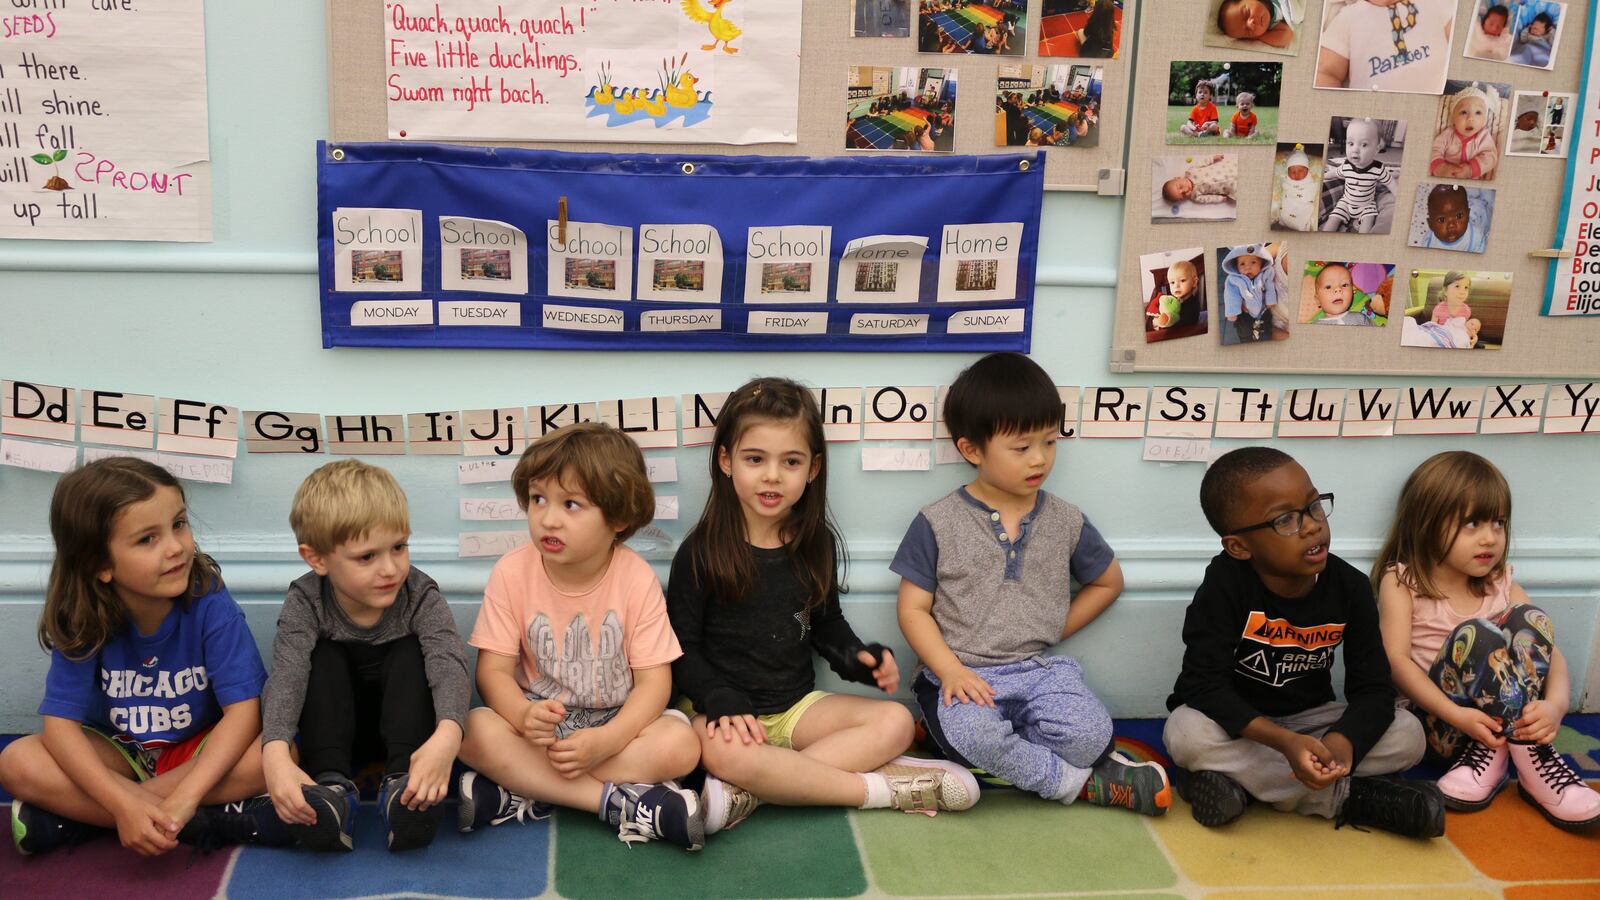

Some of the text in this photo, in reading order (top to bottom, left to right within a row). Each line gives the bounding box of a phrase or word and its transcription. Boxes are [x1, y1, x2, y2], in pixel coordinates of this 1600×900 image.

[3, 12, 57, 38] SEEDS
[18, 52, 87, 80] there.
[391, 38, 582, 78] Five little ducklings.
[1368, 44, 1430, 77] Parker
[41, 89, 110, 116] shine.
[388, 73, 550, 111] Swam right back.
[35, 123, 83, 150] fall.
[14, 192, 107, 226] up tall.
[336, 215, 417, 245] School
[443, 219, 516, 247] School
[550, 224, 622, 257] School
[642, 229, 712, 255] School
[748, 230, 825, 259] School
[945, 229, 1009, 255] Home
[847, 239, 909, 260] Home
[364, 307, 419, 318] MONDAY
[452, 307, 508, 318] TUESDAY
[544, 310, 623, 325] WEDNESDAY
[648, 314, 714, 326] THURSDAY
[764, 317, 810, 328] FRIDAY
[857, 317, 920, 329] SATURDAY
[963, 315, 1010, 326] SUNDAY
[13, 380, 68, 424] Dd
[93, 391, 147, 430] Ee
[617, 397, 659, 432] Ll
[872, 386, 928, 422] Oo
[1094, 387, 1141, 422] Rr
[1160, 386, 1207, 421] Ss
[1232, 387, 1272, 422] Tt
[1289, 388, 1334, 422] Uu
[1358, 388, 1392, 421] Vv
[1409, 386, 1472, 419] Ww
[1490, 384, 1536, 419] Xx
[1564, 382, 1600, 432] Yy
[173, 399, 228, 439] Ff
[254, 412, 320, 453] Gg
[336, 415, 393, 443] Hh
[426, 412, 454, 441] Ii
[470, 409, 514, 456] Jj
[101, 665, 208, 699] CHICAGO
[110, 703, 193, 734] CUBS
